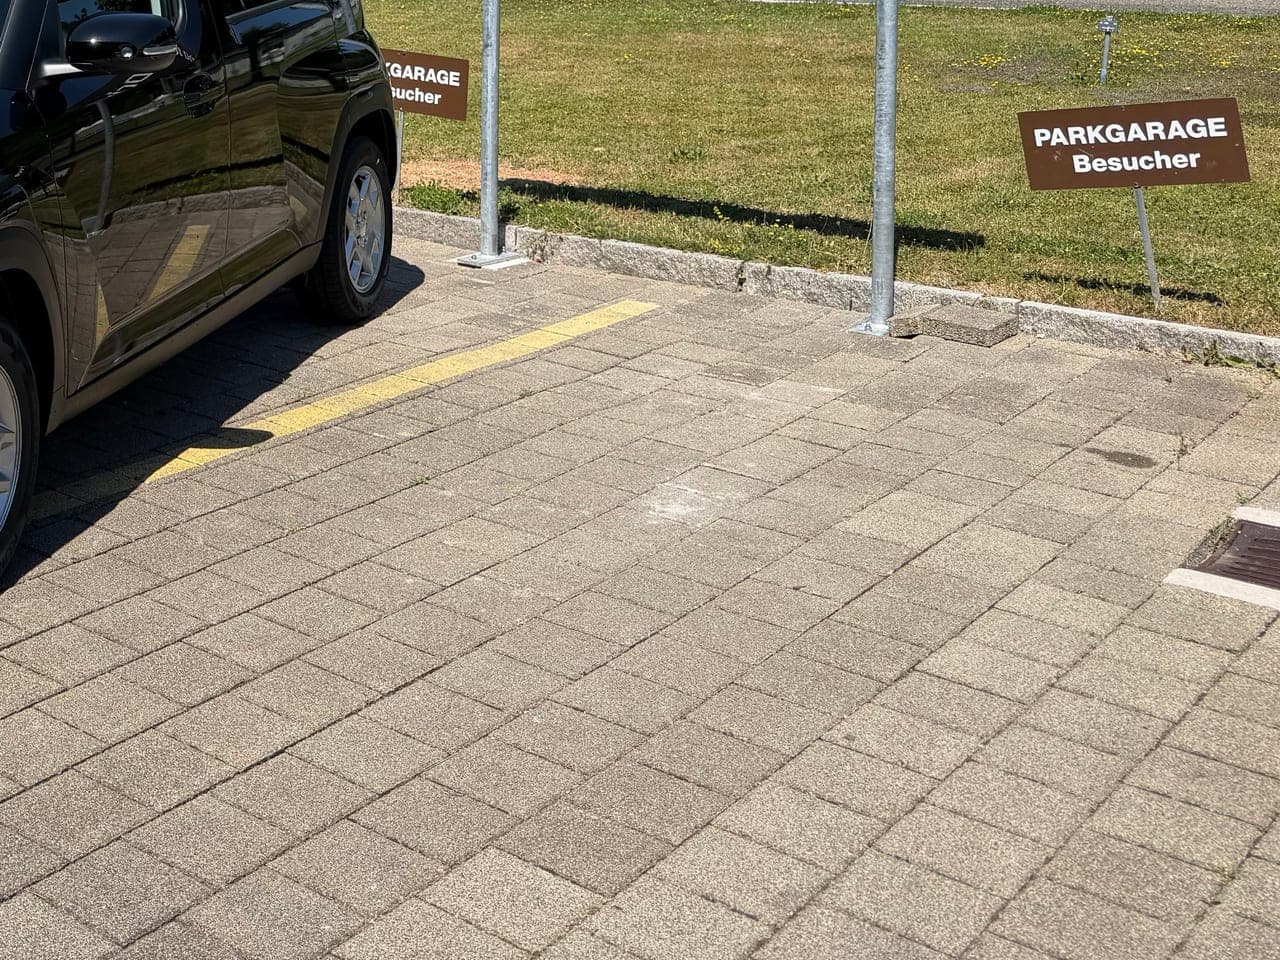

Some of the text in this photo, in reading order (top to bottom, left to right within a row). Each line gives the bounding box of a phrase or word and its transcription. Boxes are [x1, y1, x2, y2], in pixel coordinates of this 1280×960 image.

[385, 62, 461, 87] GARAGE
[391, 87, 442, 105] sucher
[1033, 117, 1228, 147] PARKGARAGE
[1072, 150, 1201, 173] Besucher
